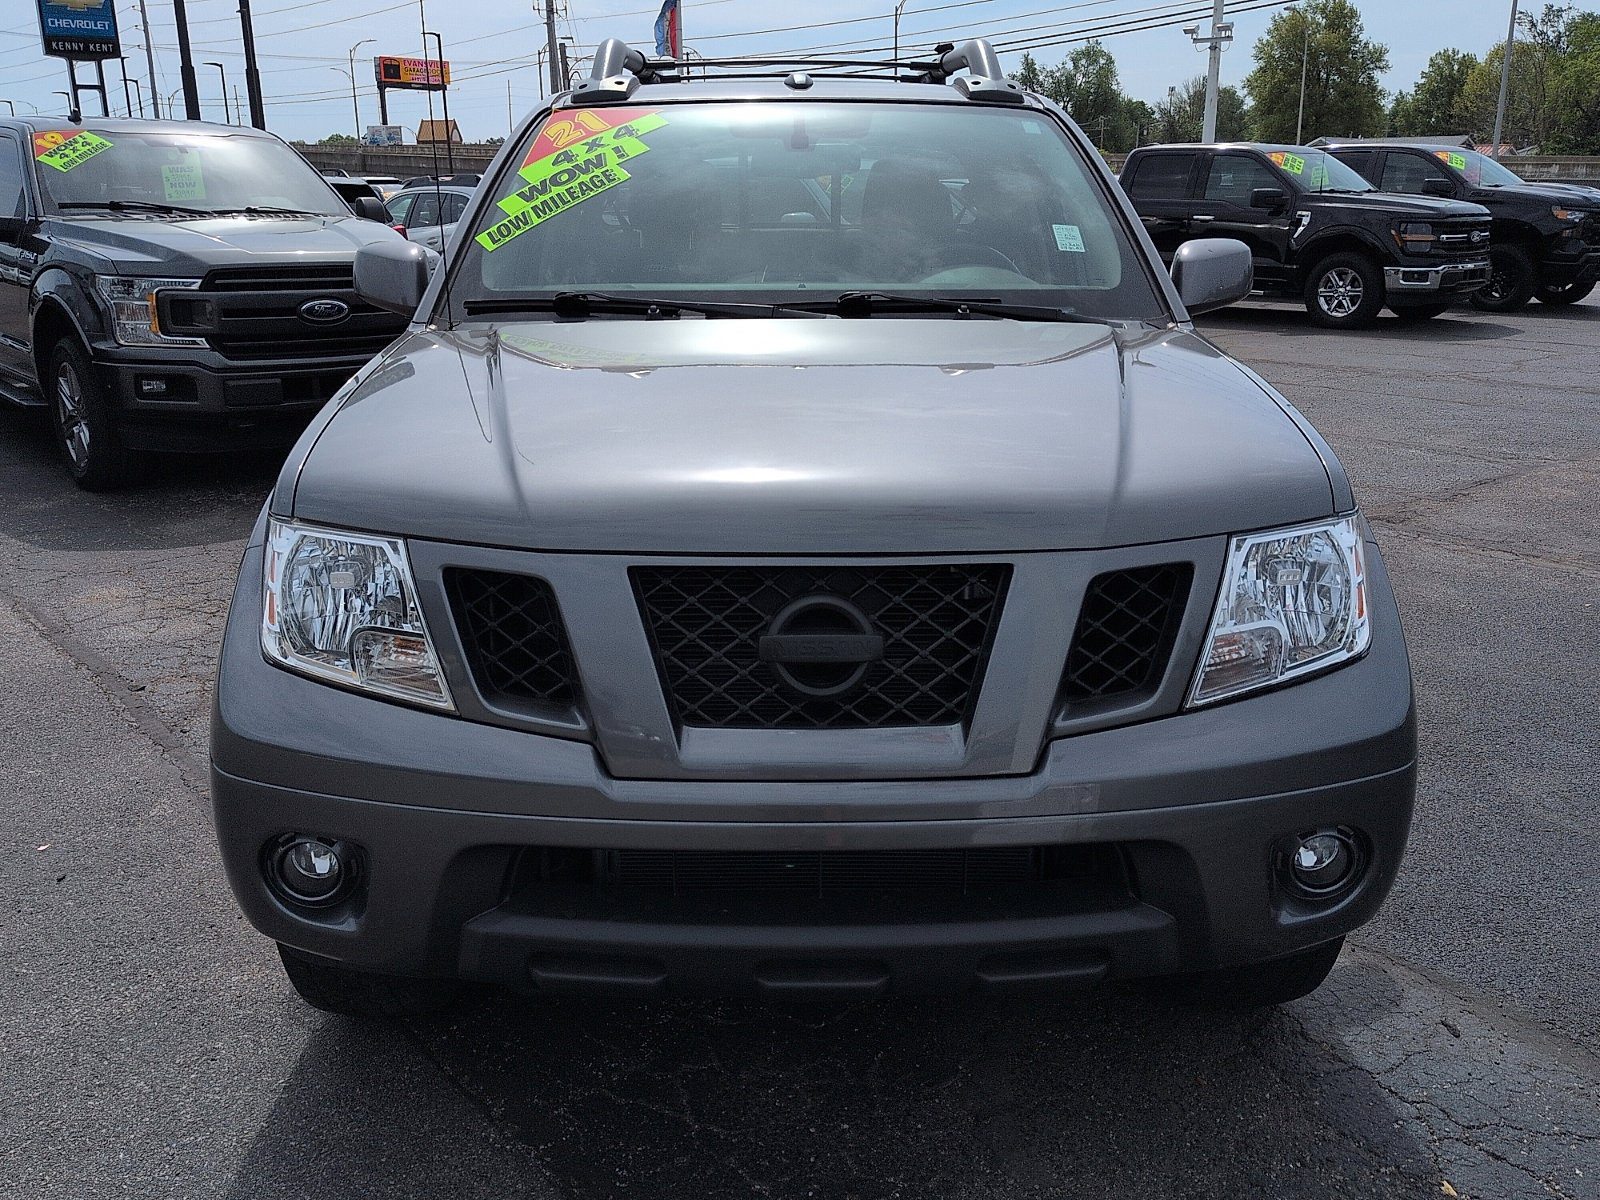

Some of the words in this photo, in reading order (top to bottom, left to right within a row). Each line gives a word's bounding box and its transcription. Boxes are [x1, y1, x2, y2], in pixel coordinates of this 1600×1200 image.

[47, 18, 109, 30] CHEVROLET
[51, 41, 84, 51] KENNY
[89, 43, 114, 53] KENT
[403, 59, 447, 69] EVANVILE
[543, 110, 612, 148] 21
[35, 132, 65, 149] 19
[59, 157, 79, 170] LOW
[75, 142, 108, 161] MILEAGE
[485, 209, 535, 246] LOW
[532, 168, 622, 220] MILEAGE
